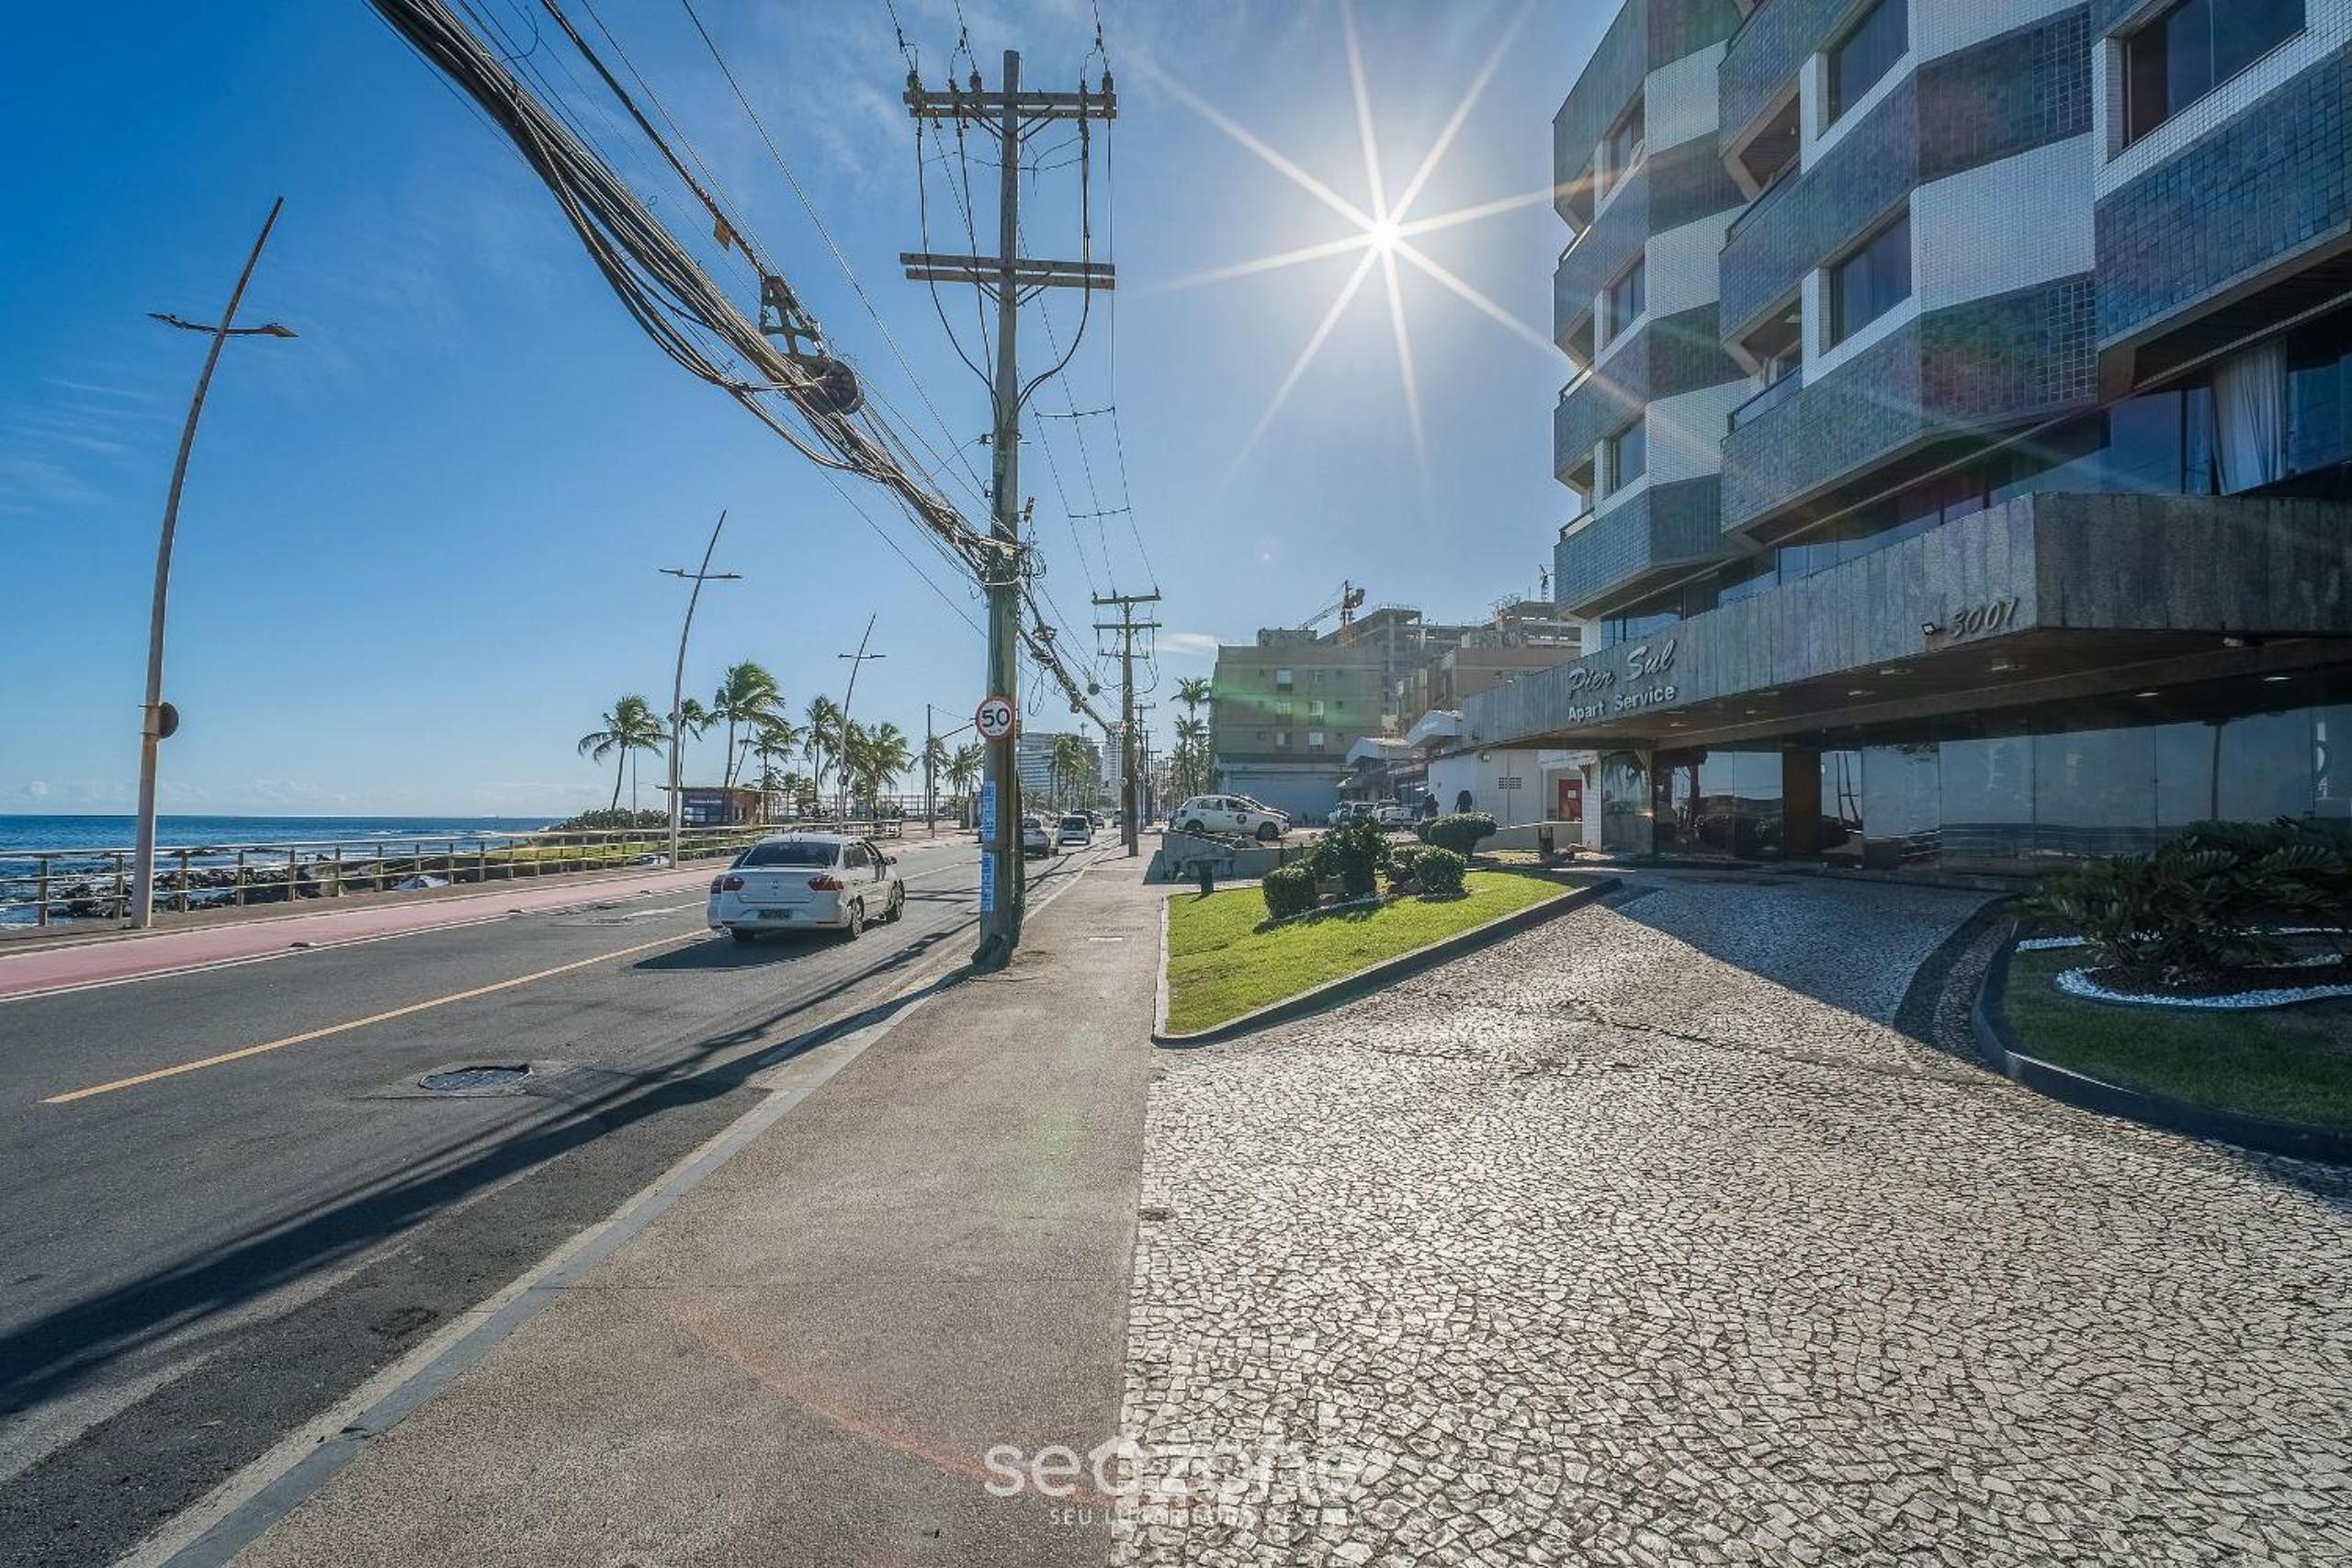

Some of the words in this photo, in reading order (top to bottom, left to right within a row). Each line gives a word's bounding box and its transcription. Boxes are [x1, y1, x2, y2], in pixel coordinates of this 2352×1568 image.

[1568, 668, 1616, 698] Pier
[1623, 639, 1676, 682] Sul
[981, 707, 1011, 728] 50
[1567, 700, 1605, 723] Apart
[1614, 686, 1676, 712] Service
